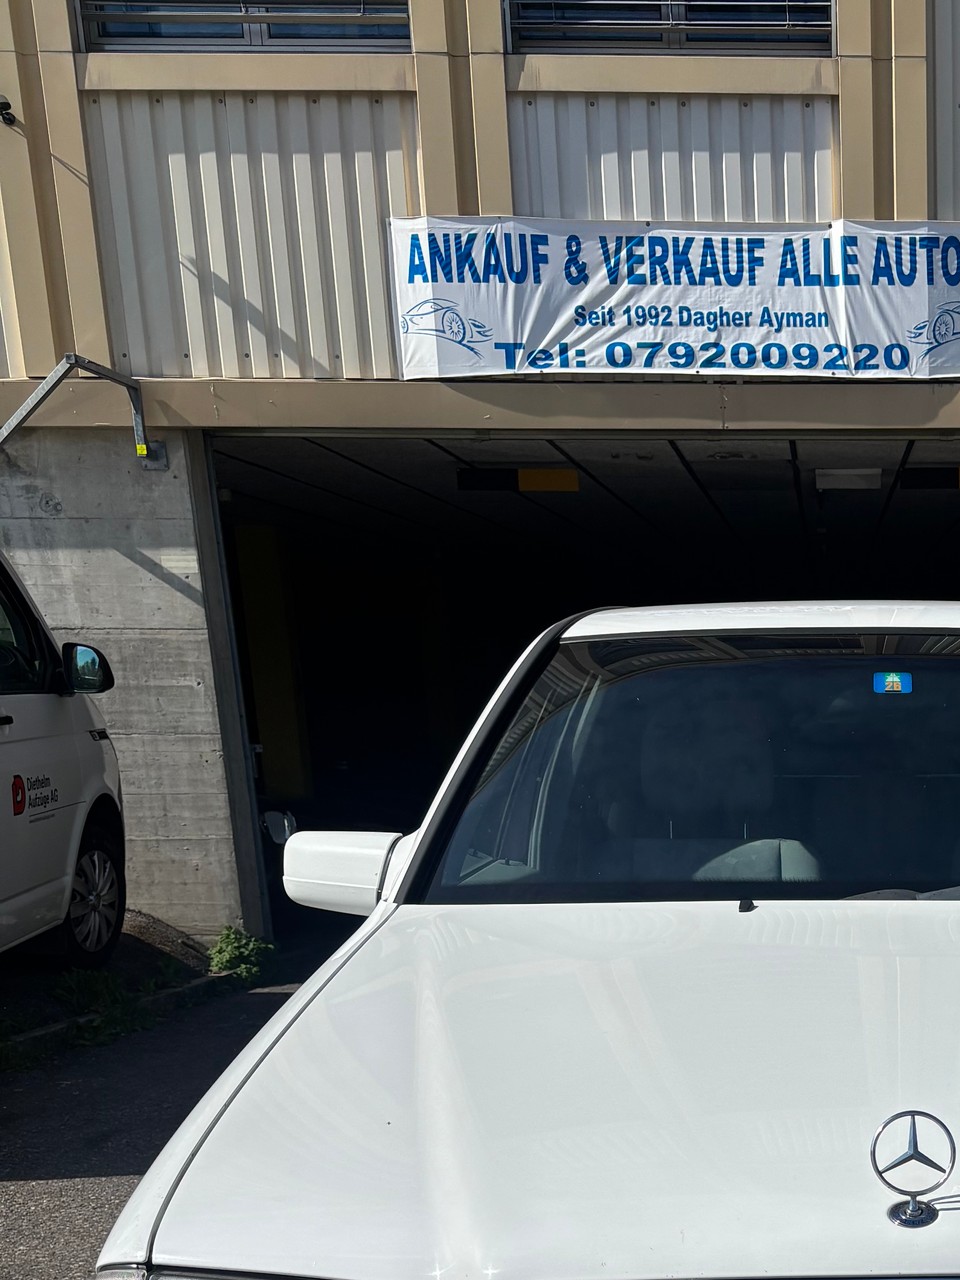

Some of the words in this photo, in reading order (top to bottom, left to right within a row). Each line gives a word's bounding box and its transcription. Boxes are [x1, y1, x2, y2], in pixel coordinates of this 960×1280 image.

[407, 231, 550, 285] ANKAUF
[563, 234, 589, 288] &
[598, 235, 766, 288] VERKAUF
[776, 236, 861, 289] ALLE
[574, 305, 615, 328] Seit
[622, 305, 673, 328] 1992
[677, 305, 753, 333] Dagher
[758, 306, 829, 333] Ayman
[492, 341, 587, 370] Tel:
[605, 341, 910, 372] 0792009220
[27, 774, 51, 791] Diethelm
[51, 788, 59, 803] AG
